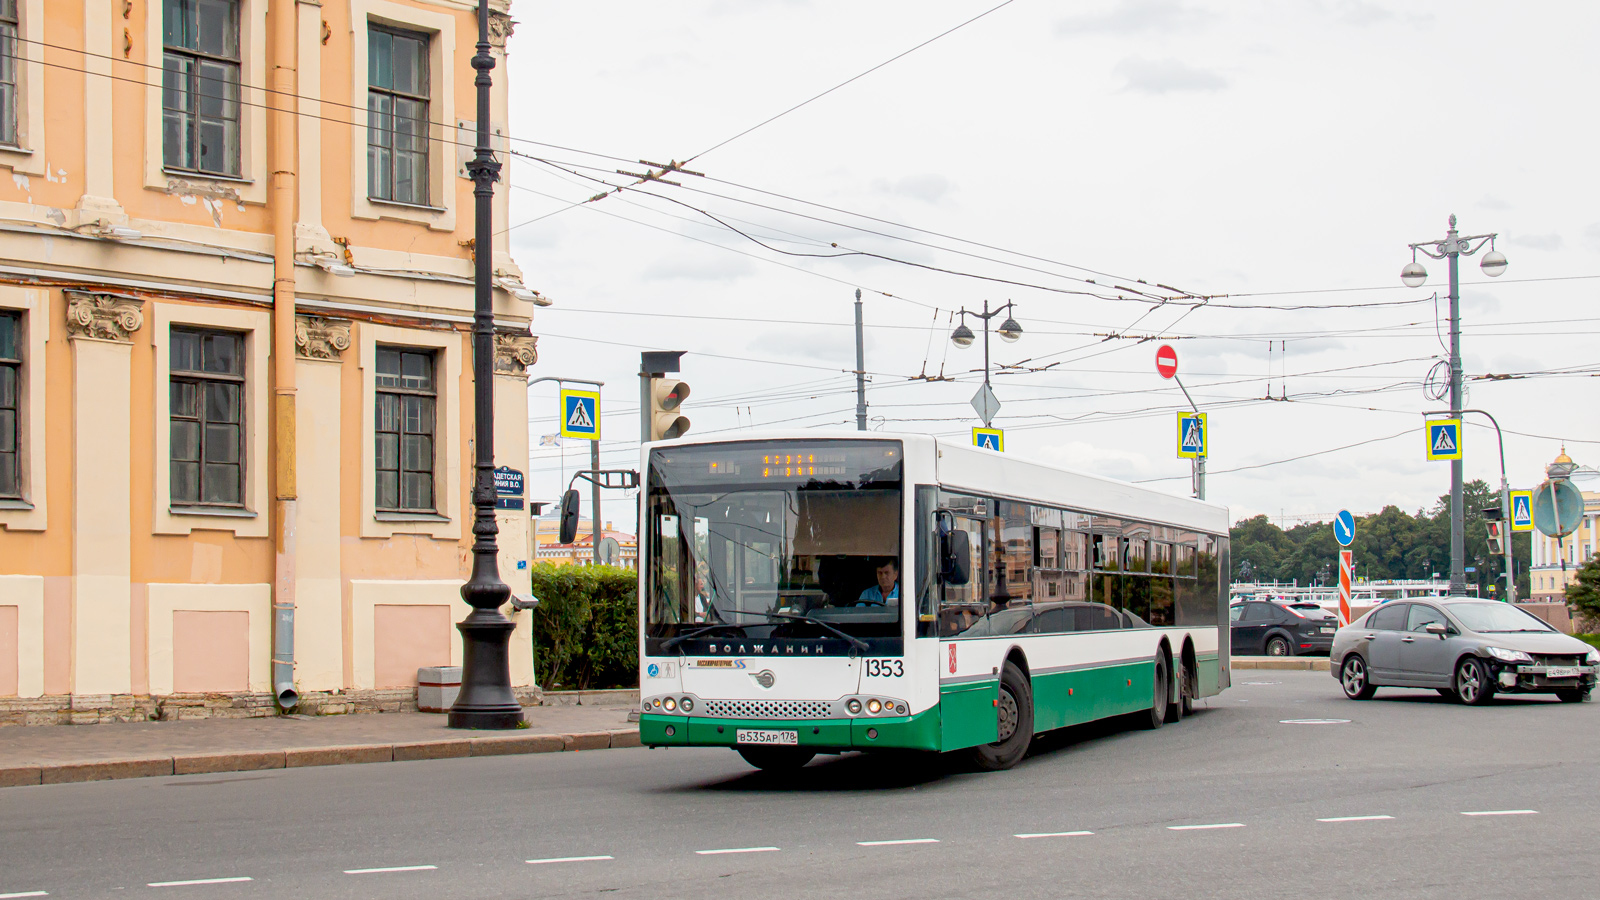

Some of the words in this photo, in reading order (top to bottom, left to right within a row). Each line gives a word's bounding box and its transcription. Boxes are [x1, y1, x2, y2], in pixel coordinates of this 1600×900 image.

[494, 472, 522, 480] АДЕТСКАЯ
[709, 644, 824, 654] ВОЛЖАНИН
[865, 659, 905, 677] 1353
[740, 731, 778, 742] В535АР
[780, 731, 795, 740] 178
